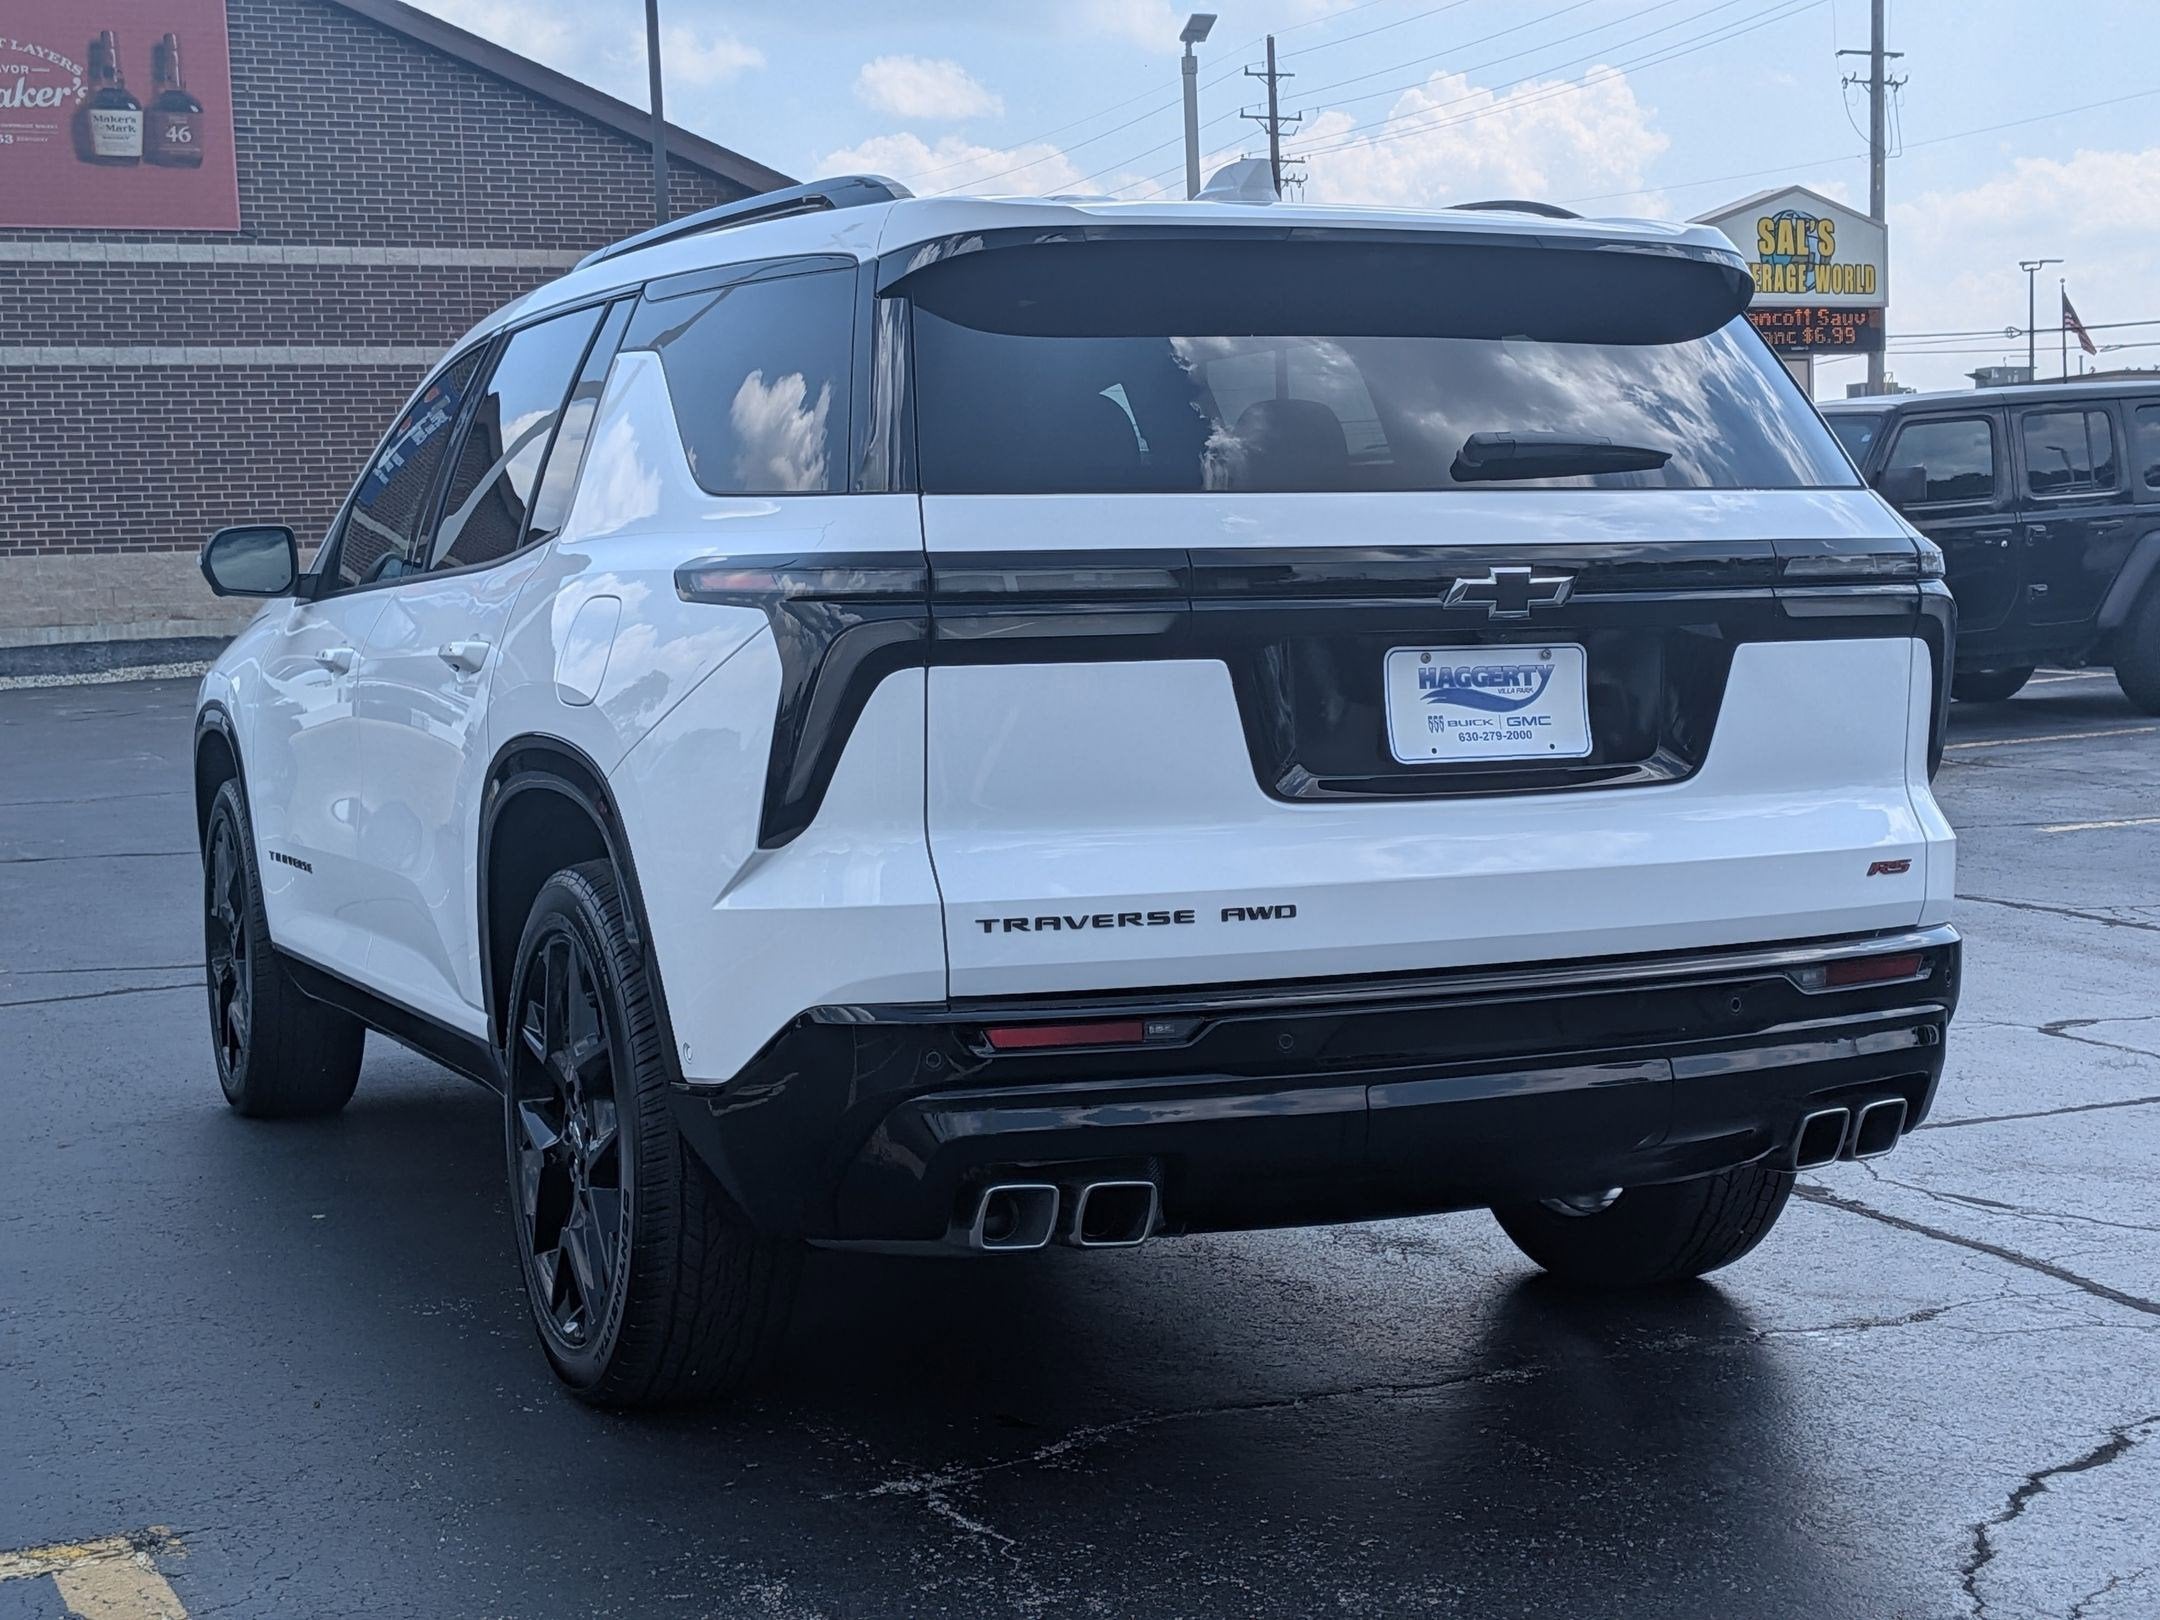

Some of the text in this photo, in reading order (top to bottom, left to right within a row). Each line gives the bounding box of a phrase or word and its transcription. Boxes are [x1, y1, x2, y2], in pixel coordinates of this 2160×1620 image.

[11, 39, 84, 76] LAYERS
[0, 64, 29, 74] VOR
[93, 114, 137, 124] Maker's
[105, 123, 137, 133] Mark
[165, 125, 192, 143] 46
[1757, 216, 1836, 257] SAL'S
[1749, 263, 1876, 294] ERAGE WORLD
[1817, 308, 1866, 326] Sauv
[1802, 326, 1857, 345] $6.99
[1418, 664, 1556, 690] HAGGERTY
[1447, 715, 1552, 727] BUICK GMC
[1458, 730, 1533, 742] 630-279-2000
[1866, 858, 1913, 877] RS
[975, 904, 1297, 934] TRAVERSE AWD
